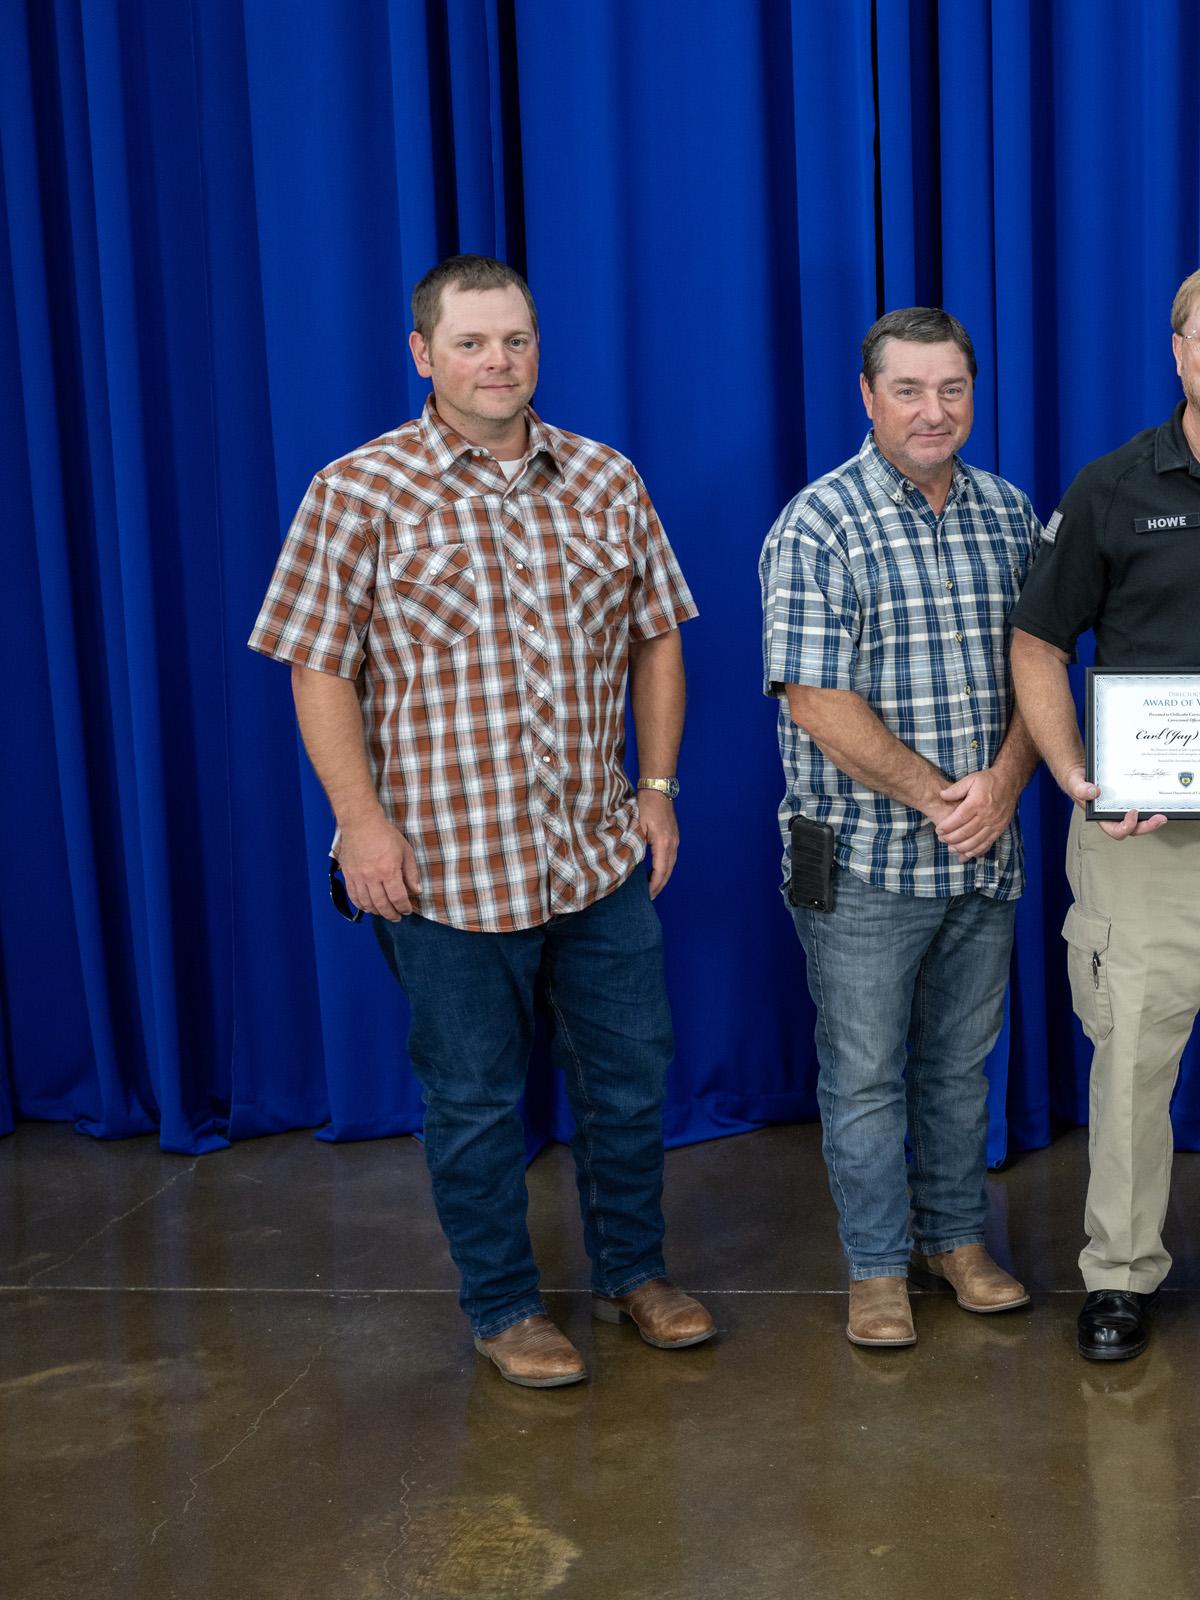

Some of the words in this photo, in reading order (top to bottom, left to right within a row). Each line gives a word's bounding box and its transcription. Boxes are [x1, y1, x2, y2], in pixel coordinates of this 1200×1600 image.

[1147, 516, 1187, 529] HOWE
[1143, 698, 1178, 707] AWARD
[1180, 698, 1193, 707] OF
[1135, 727, 1170, 740] Carl
[1164, 729, 1200, 747] (Jay)
